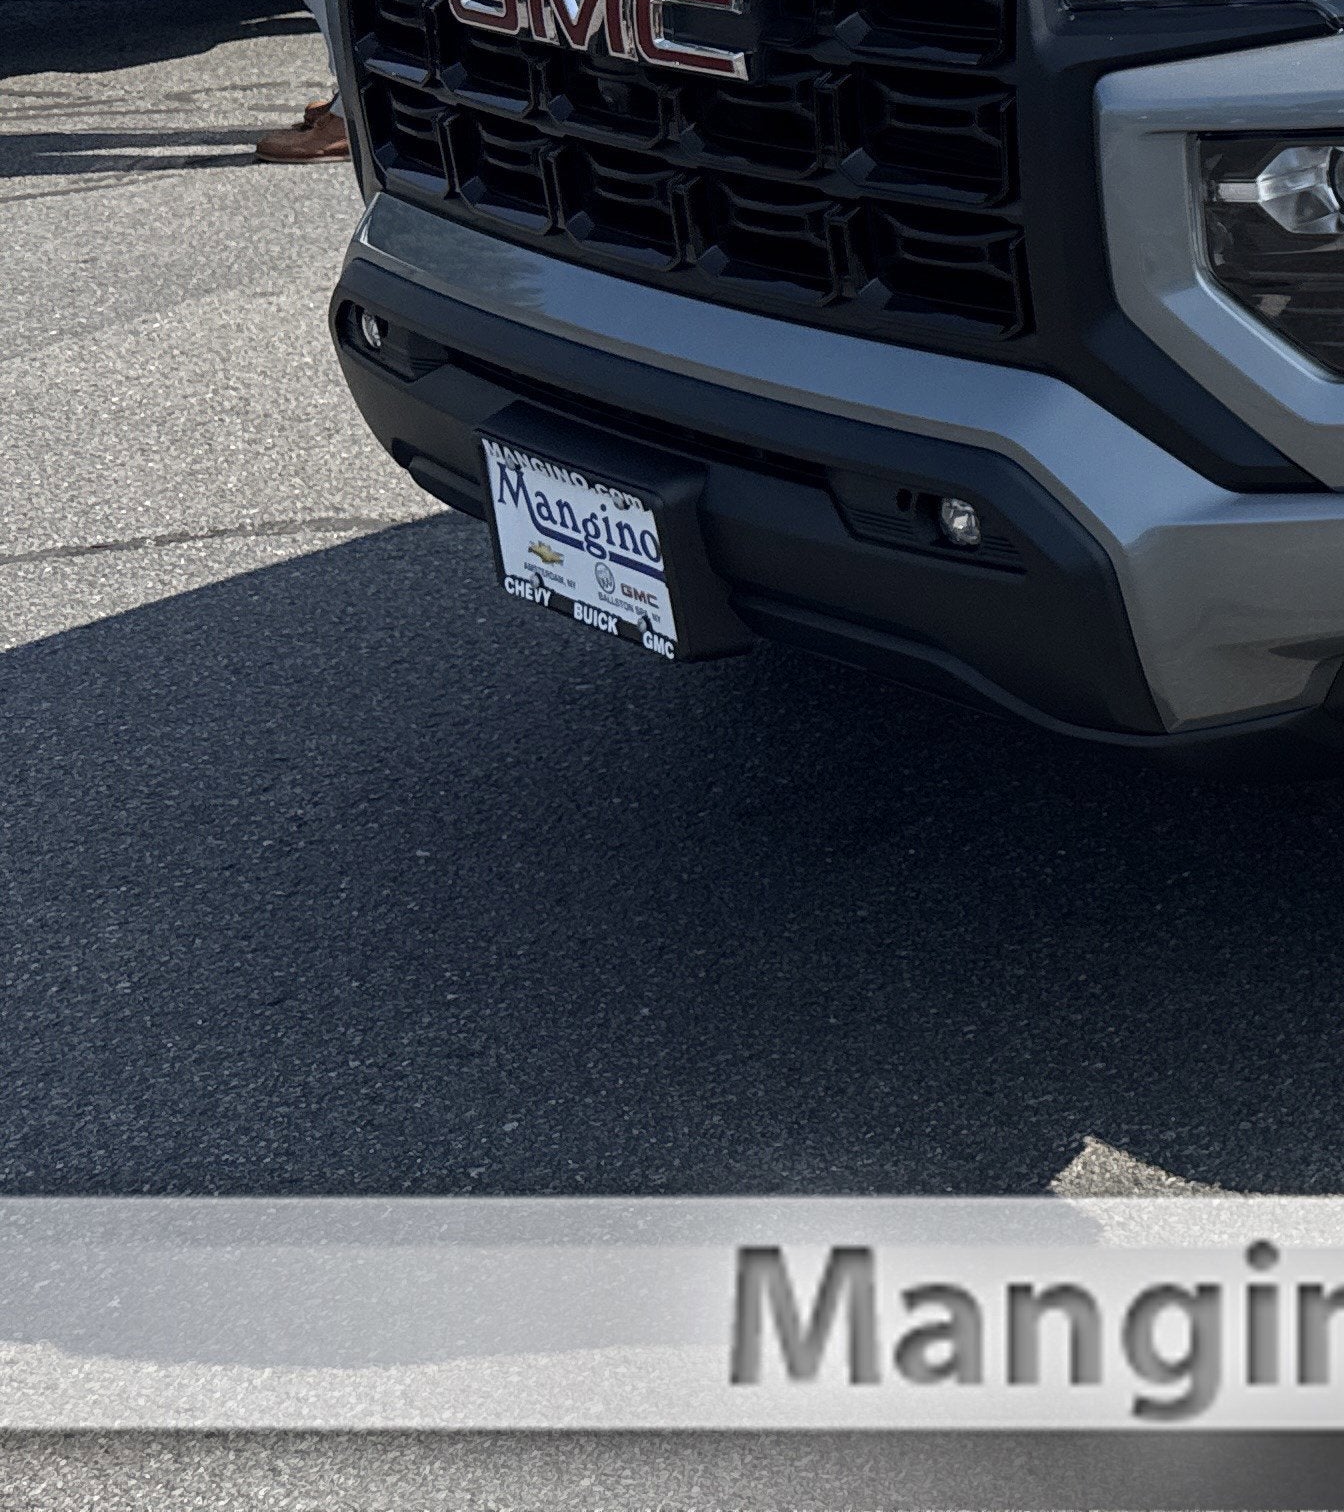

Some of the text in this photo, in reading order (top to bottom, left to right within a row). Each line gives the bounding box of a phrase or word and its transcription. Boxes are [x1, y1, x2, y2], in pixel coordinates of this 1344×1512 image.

[497, 462, 665, 580] Mangino
[504, 576, 675, 660] CHEVY BUICK GMC
[620, 582, 660, 609] GMC
